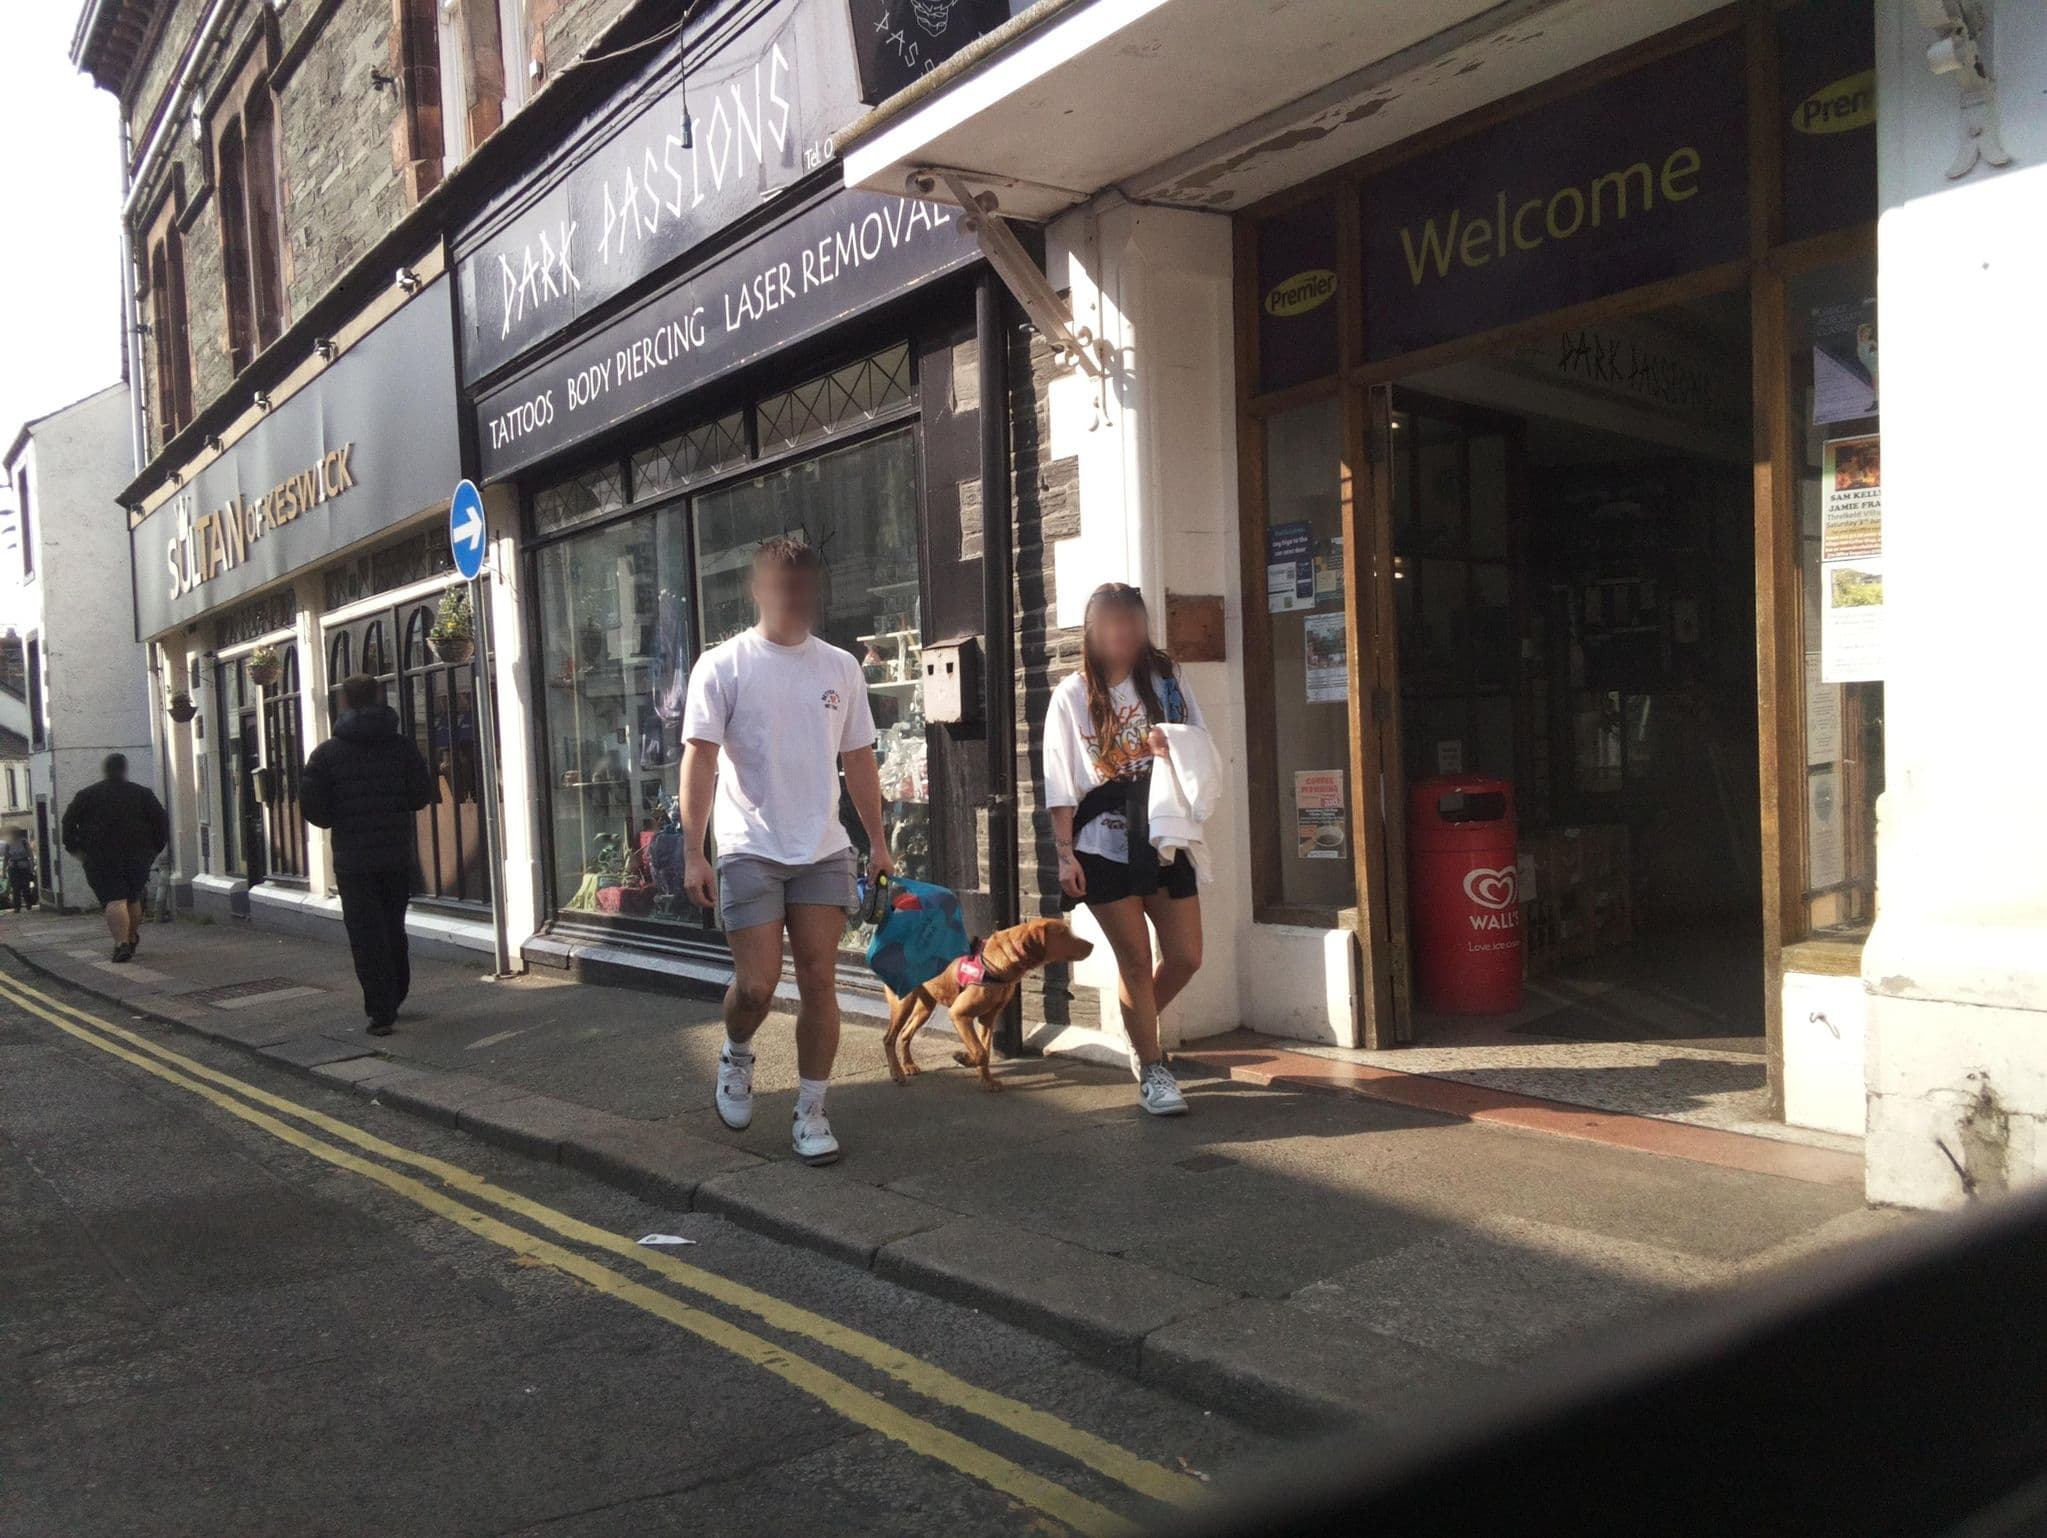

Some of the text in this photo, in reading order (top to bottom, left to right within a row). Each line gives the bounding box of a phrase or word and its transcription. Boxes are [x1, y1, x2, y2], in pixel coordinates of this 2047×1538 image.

[498, 43, 790, 341] DARK PASSIONS
[1400, 147, 1700, 285] Welcome
[489, 198, 950, 449] TATTOOS BODY PIERCING LASER REMOVAL
[1271, 273, 1335, 311] Premier
[167, 493, 247, 600] SULTAN
[265, 442, 356, 528] KESWICK
[1829, 503, 1859, 512] JAMIE
[1468, 910, 1519, 930] WALL'S
